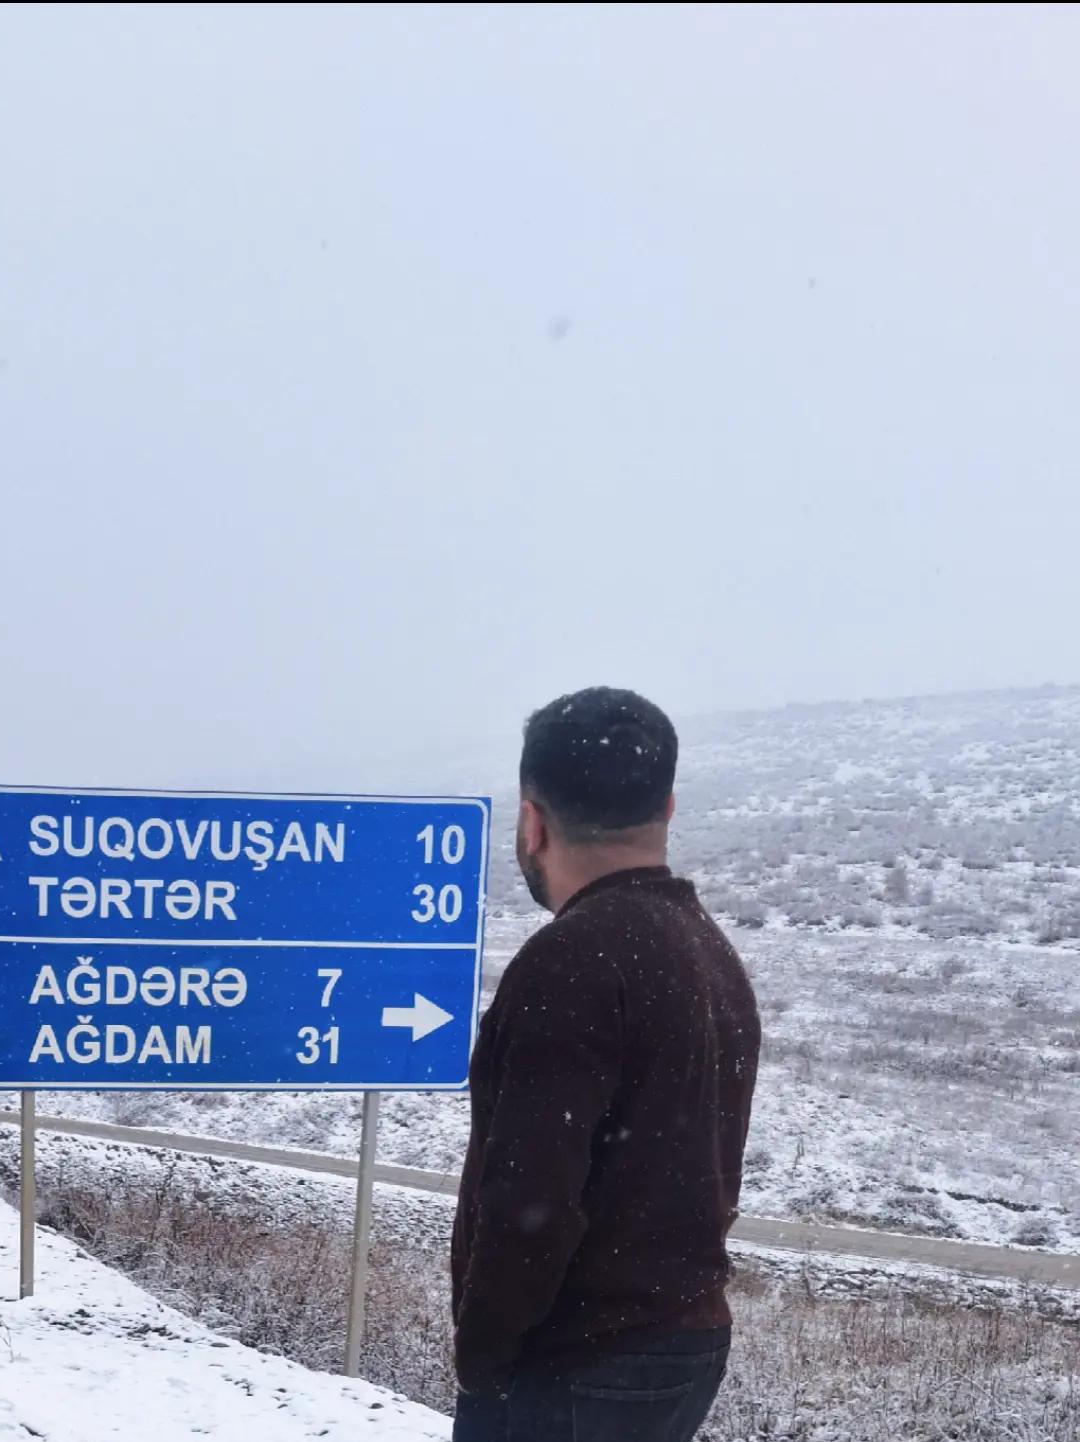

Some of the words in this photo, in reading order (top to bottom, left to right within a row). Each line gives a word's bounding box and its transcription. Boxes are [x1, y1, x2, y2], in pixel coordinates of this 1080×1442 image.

[29, 815, 345, 871] SUQOVUŞAN
[417, 824, 466, 865] 10
[28, 876, 237, 921] TƏRTƏR
[411, 883, 462, 923] 30
[29, 956, 248, 1007] AĞDƏRƏ
[317, 968, 343, 1007] 7
[28, 1015, 212, 1064] AĞDAM
[296, 1026, 340, 1065] 31
